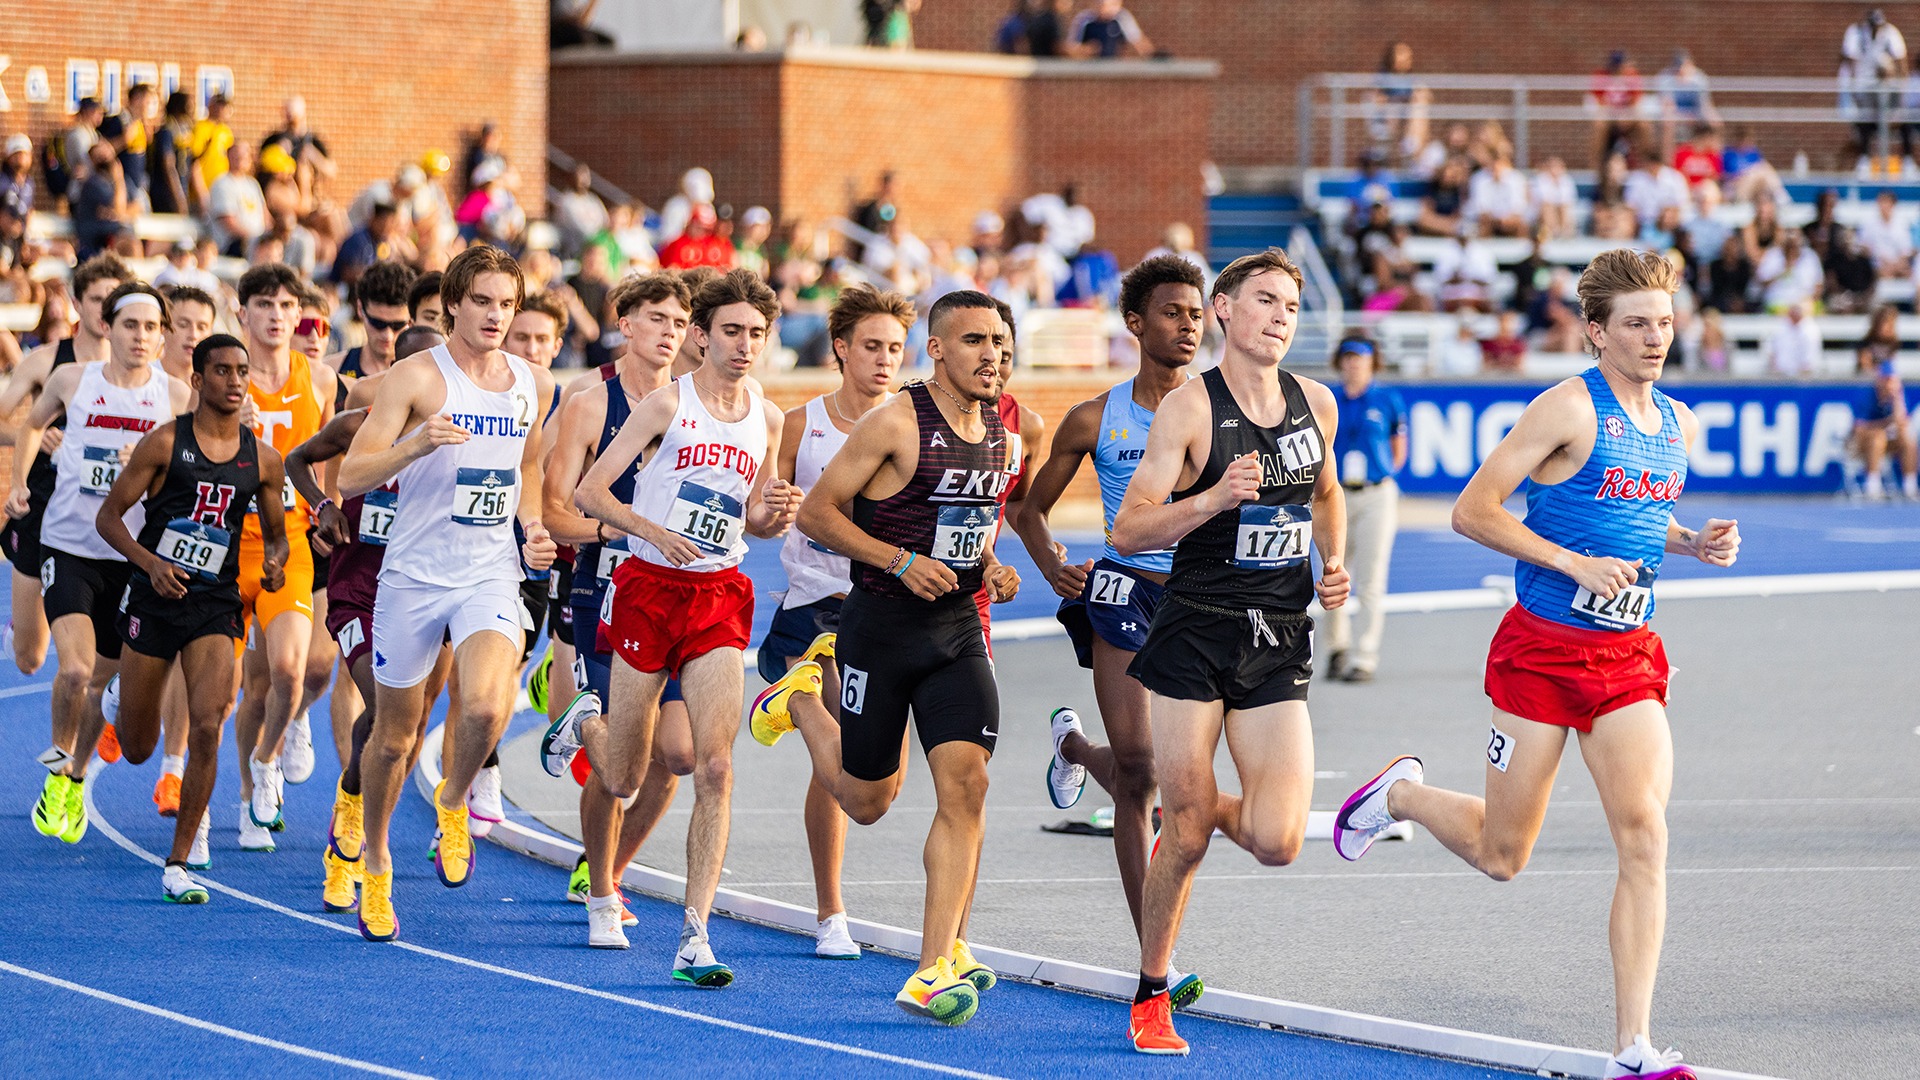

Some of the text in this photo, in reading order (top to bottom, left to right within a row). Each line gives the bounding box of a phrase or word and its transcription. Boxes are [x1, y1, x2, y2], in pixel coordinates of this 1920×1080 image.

[517, 394, 528, 427] 2
[1220, 419, 1239, 428] ACC
[674, 443, 758, 486] BOSTON
[1287, 434, 1315, 466] 11
[933, 468, 1003, 498] EKU
[1234, 452, 1315, 487] AKE
[1595, 466, 1685, 502] Rebels
[191, 481, 236, 529] H
[467, 491, 507, 516] 756
[683, 509, 729, 544] 156
[172, 539, 213, 567] 619
[948, 531, 985, 559] 369
[1246, 528, 1303, 558] 1771
[1095, 573, 1123, 602] 21
[1582, 591, 1645, 621] 1244
[845, 672, 860, 709] 6
[1487, 727, 1506, 764] 23
